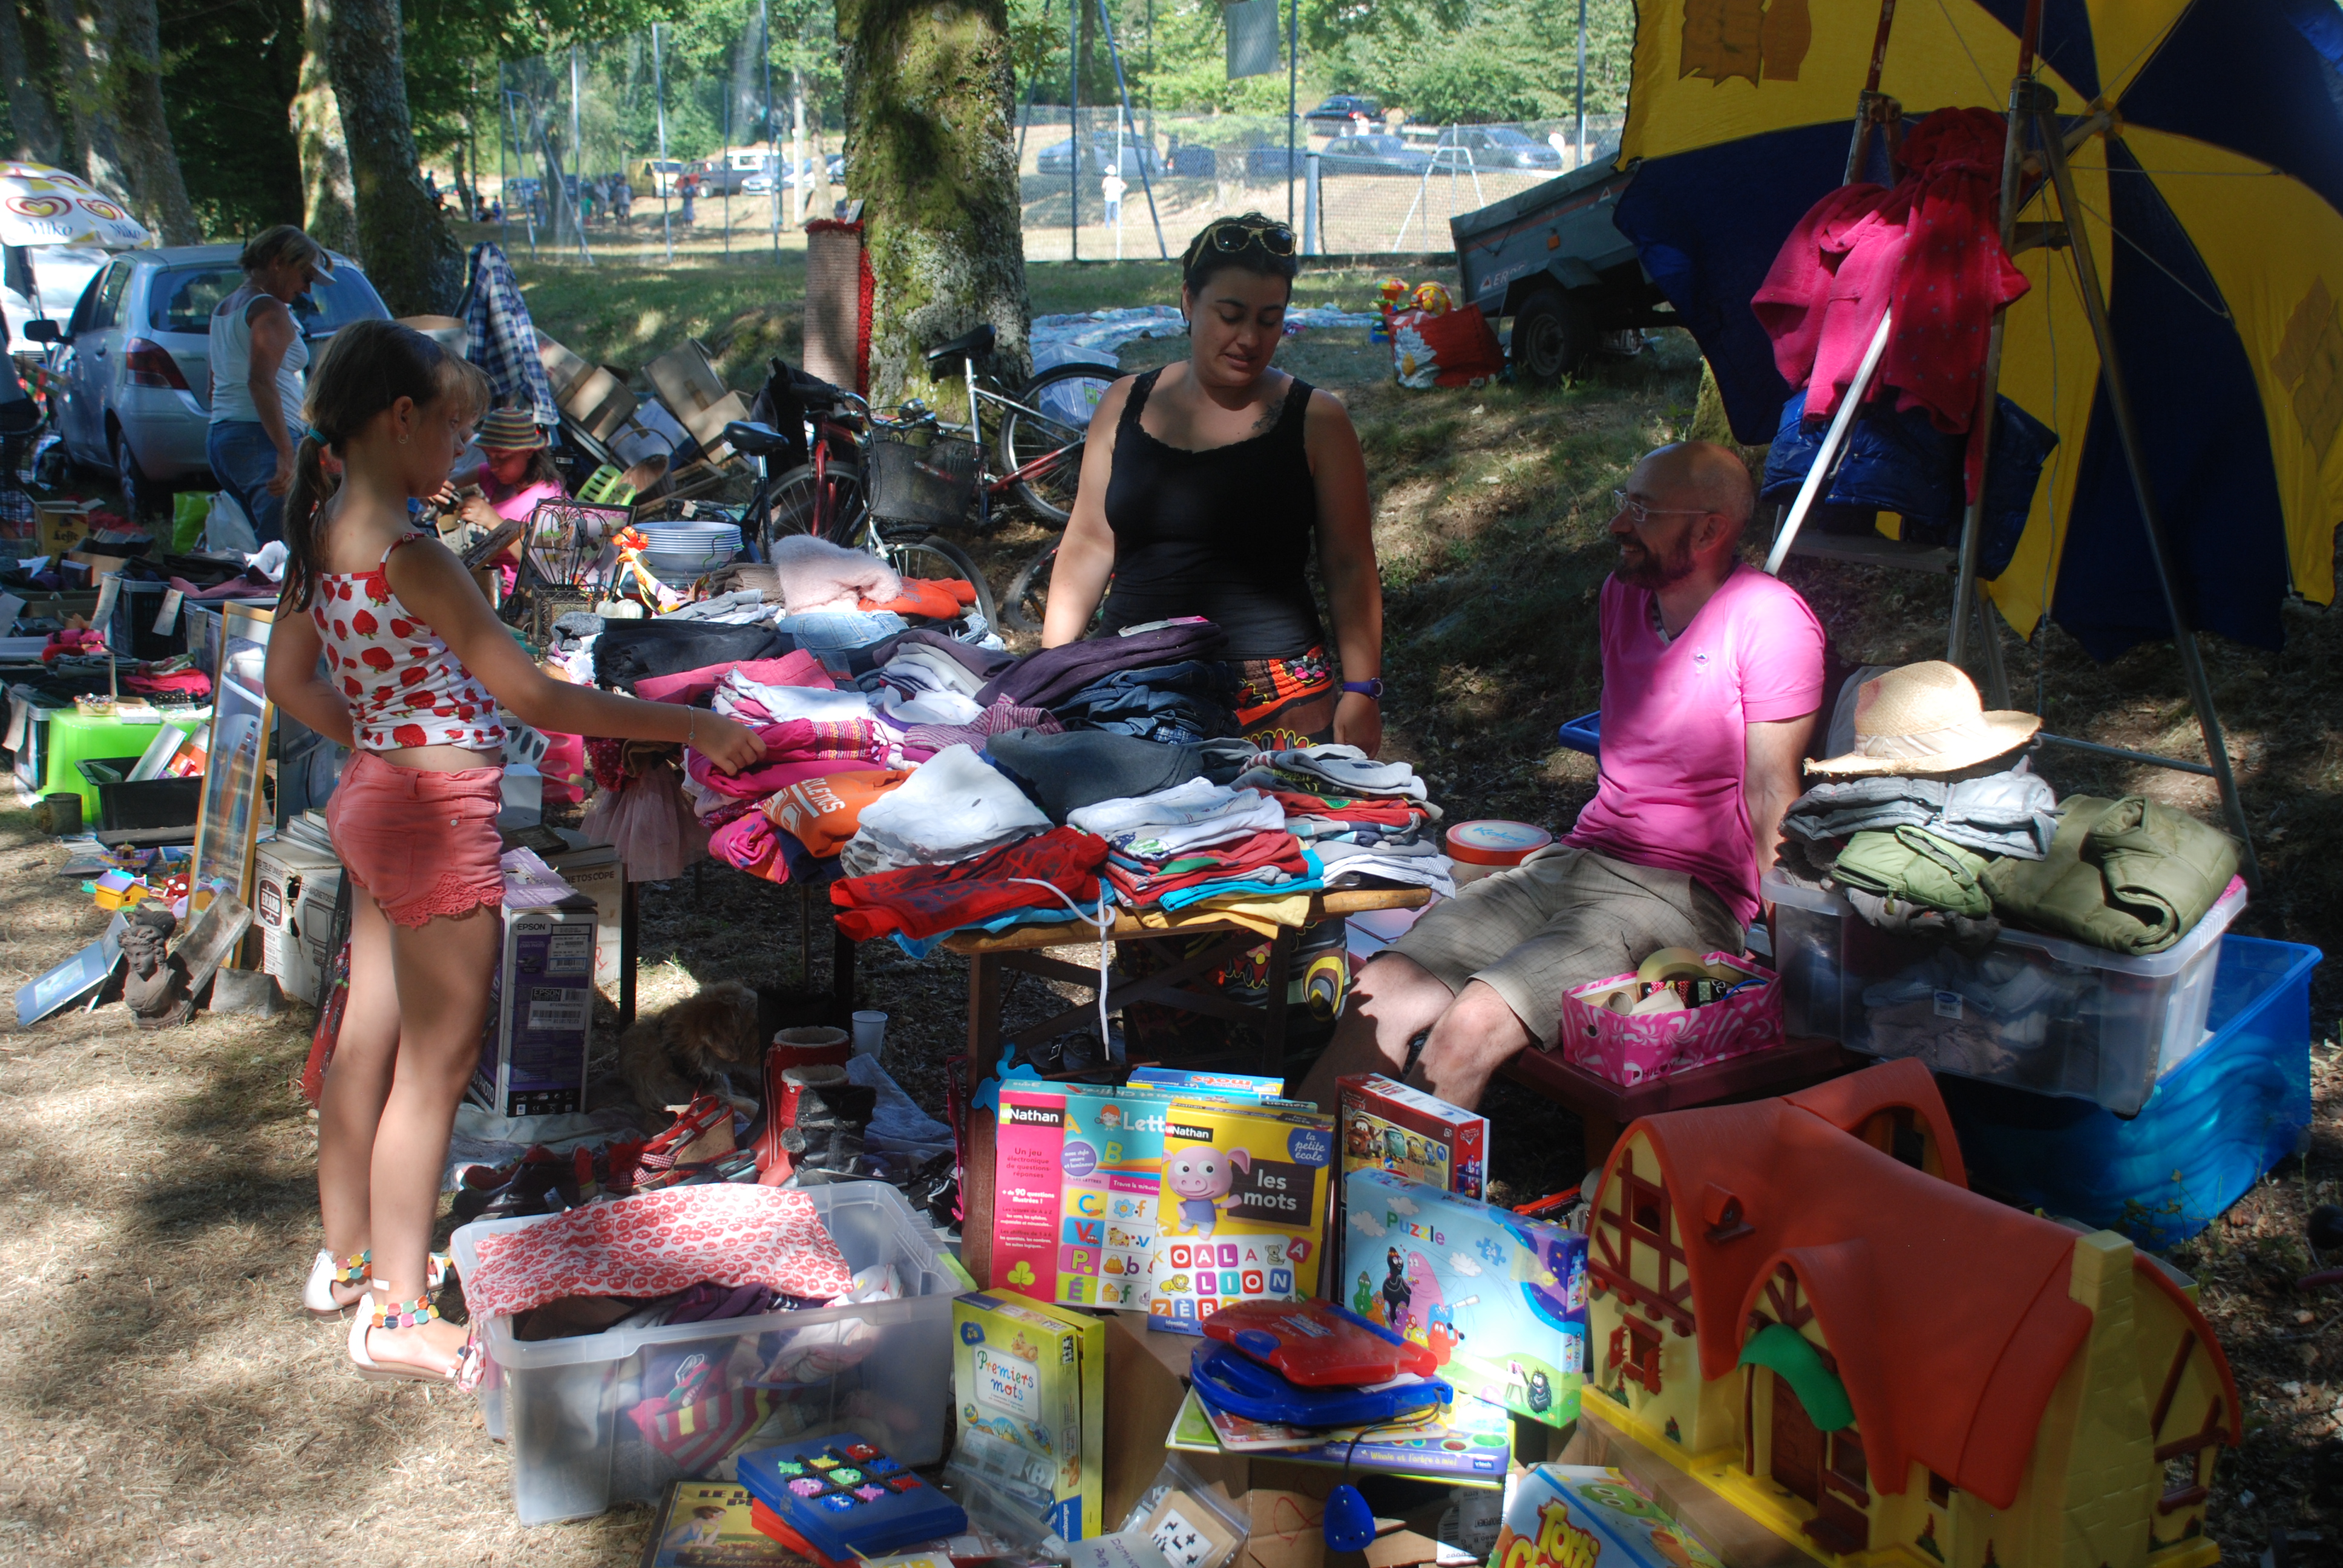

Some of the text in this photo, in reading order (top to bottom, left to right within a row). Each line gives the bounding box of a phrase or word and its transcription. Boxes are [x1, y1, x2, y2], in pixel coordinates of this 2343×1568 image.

[27, 221, 73, 237] Miko
[565, 871, 615, 884] NETOSCOPE
[262, 892, 280, 912] ERARD
[478, 1076, 494, 1102] PHOTO
[1191, 1076, 1253, 1086] mots
[1010, 1108, 1059, 1123] Nathan
[1123, 1111, 1166, 1132] Lett
[1172, 1125, 1209, 1140] Nathan
[1306, 1131, 1316, 1141] la
[1029, 1148, 1042, 1157] jeu
[1103, 1140, 1124, 1165] B
[1294, 1140, 1325, 1152] petite
[1007, 1155, 1049, 1165] électronique
[1295, 1150, 1323, 1161] école
[1257, 1168, 1287, 1190] les
[1078, 1193, 1096, 1214] C
[1136, 1200, 1147, 1218] f
[1244, 1192, 1297, 1210] mots
[1074, 1221, 1095, 1243] V
[1386, 1210, 1446, 1246] Puzzle
[1071, 1249, 1089, 1270] P
[1290, 1243, 1305, 1258] A
[1486, 1246, 1498, 1256] 24
[1126, 1255, 1140, 1275] b
[1067, 1276, 1084, 1302] É
[1121, 1284, 1132, 1303] f
[977, 1350, 1034, 1388] Premiers
[991, 1379, 1023, 1401] mots
